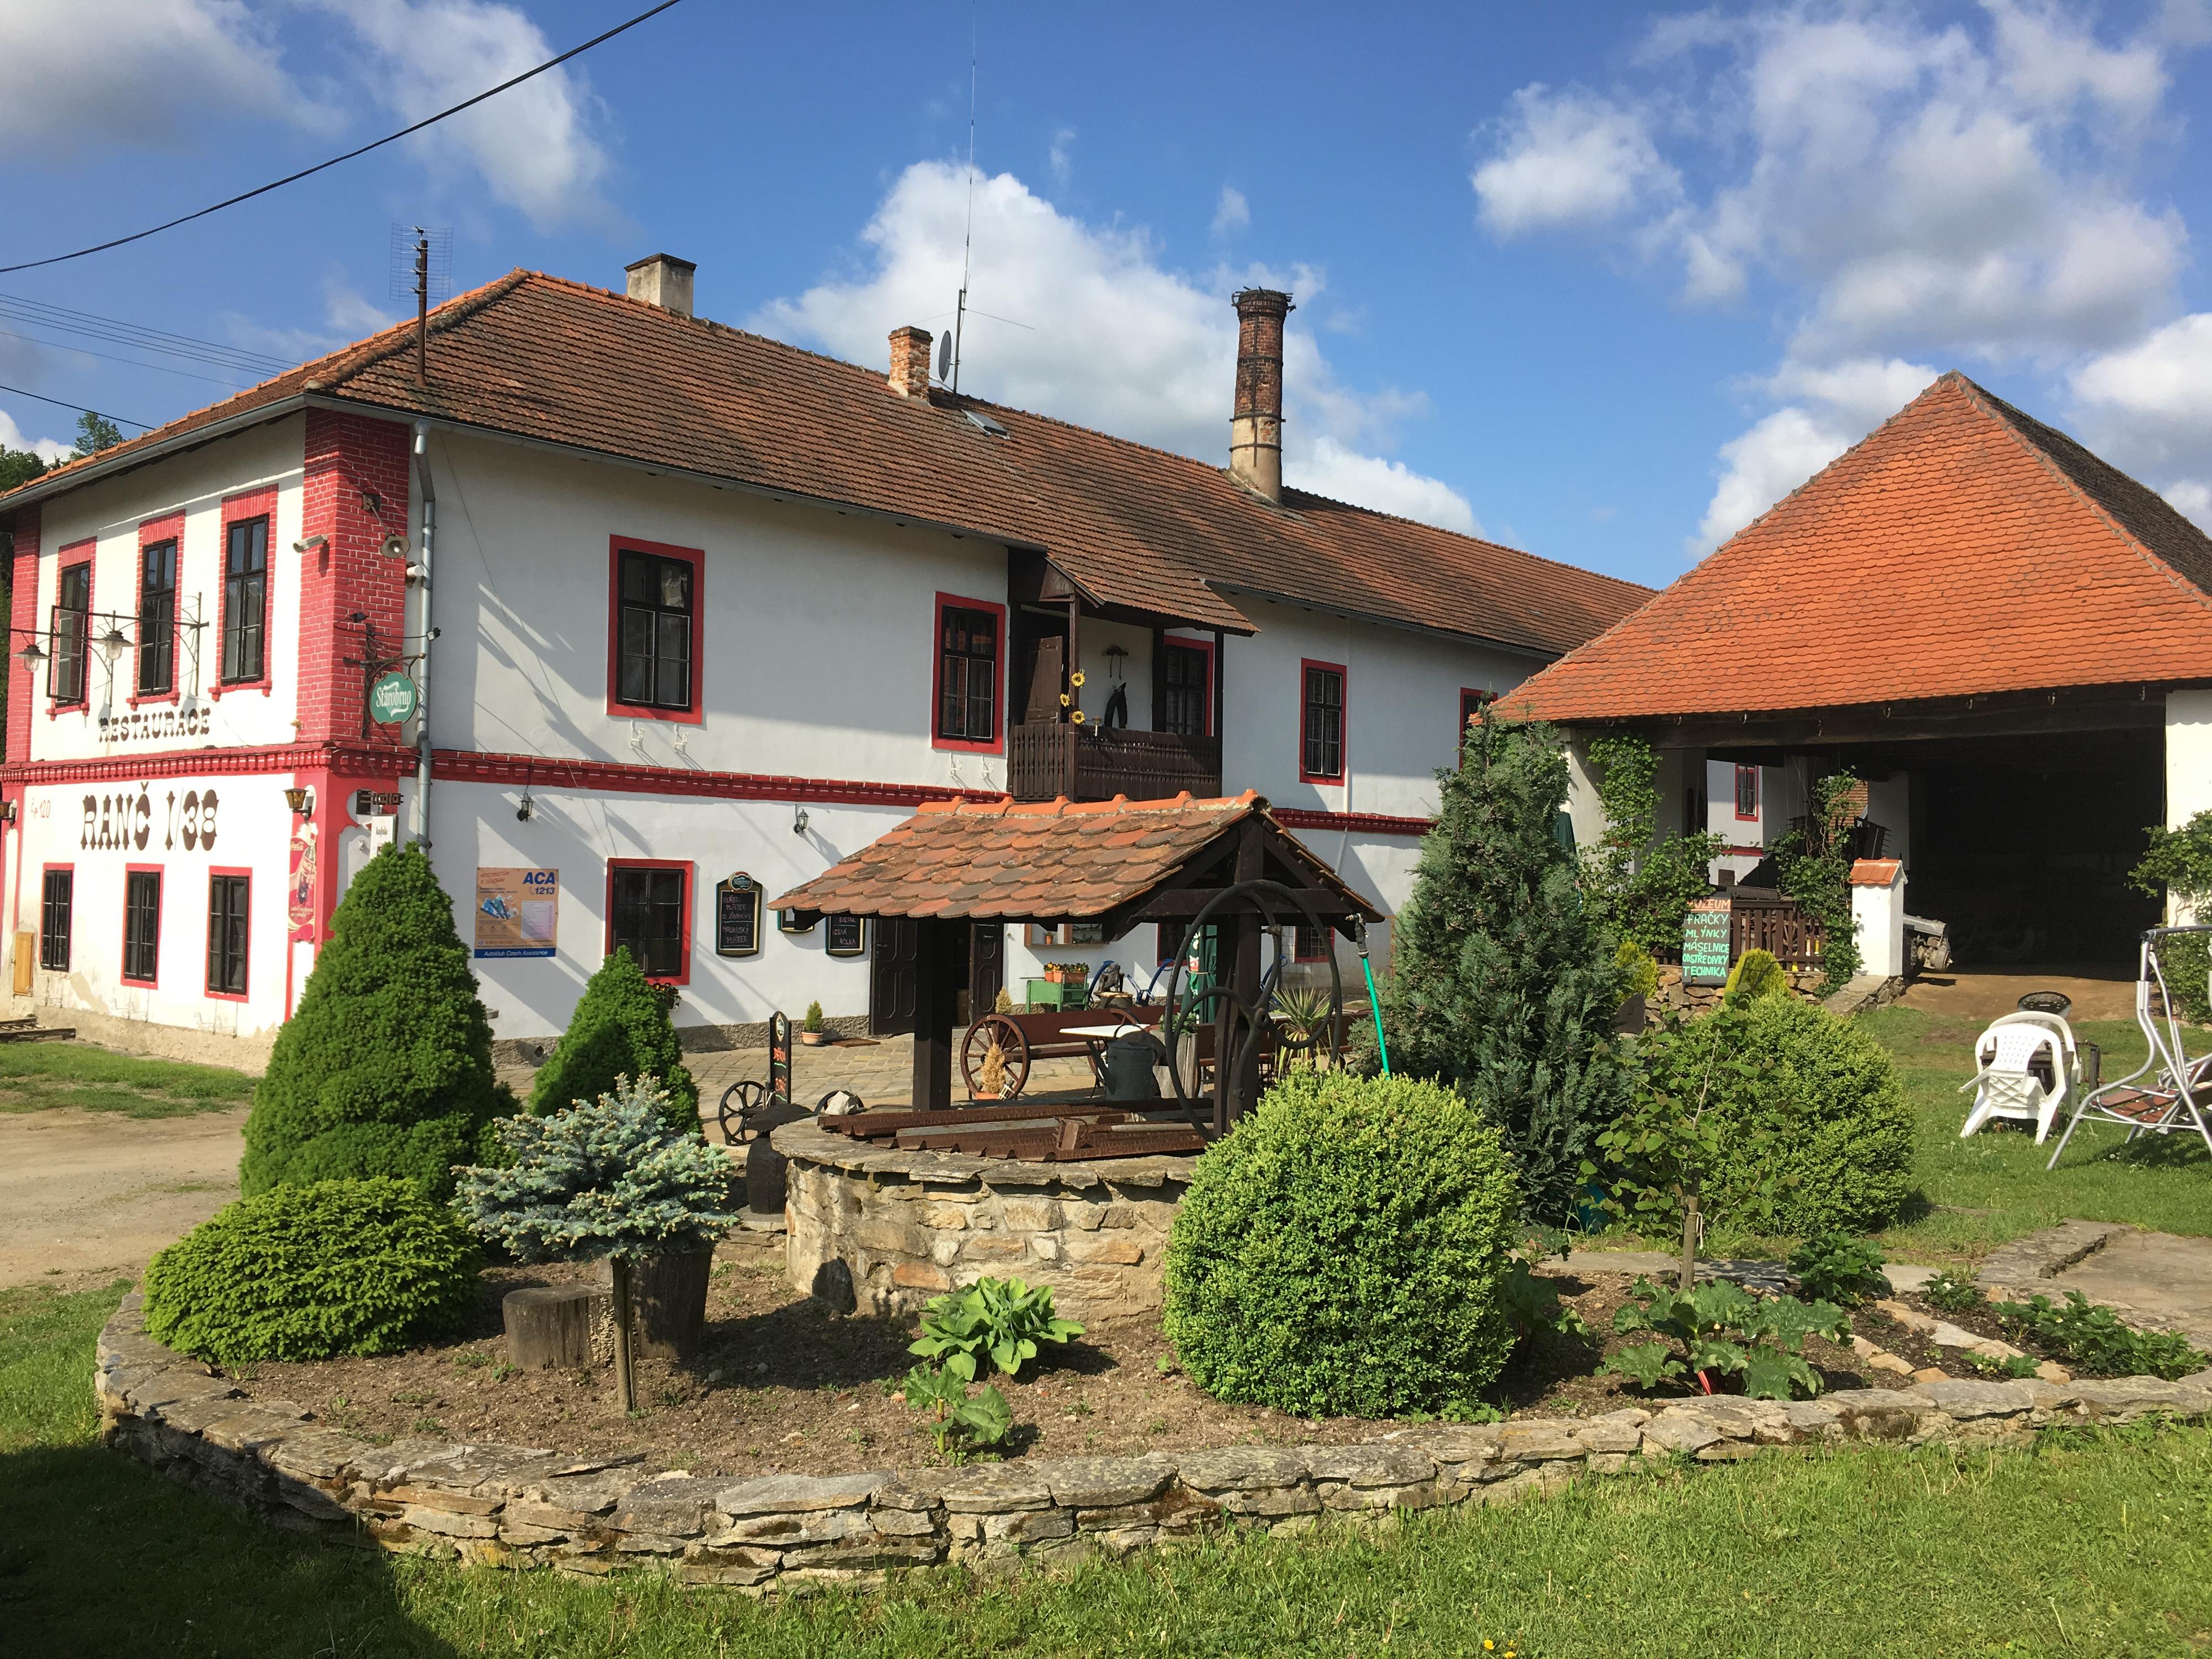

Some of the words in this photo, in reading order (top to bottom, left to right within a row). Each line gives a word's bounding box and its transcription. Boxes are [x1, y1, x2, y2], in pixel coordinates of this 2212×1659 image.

[376, 682, 411, 716] Starobrno
[99, 708, 210, 743] RESTAURACE
[40, 800, 51, 818] 120
[80, 781, 150, 851] RANČ
[522, 872, 555, 884] ACA
[1687, 899, 1731, 909] UZEUM
[1687, 911, 1729, 925] PRAČKY
[1683, 938, 1730, 953] MÁSELNICE
[1682, 952, 1729, 965] ODSTŘEDIVKY
[1683, 966, 1726, 978] TECHNIKA
